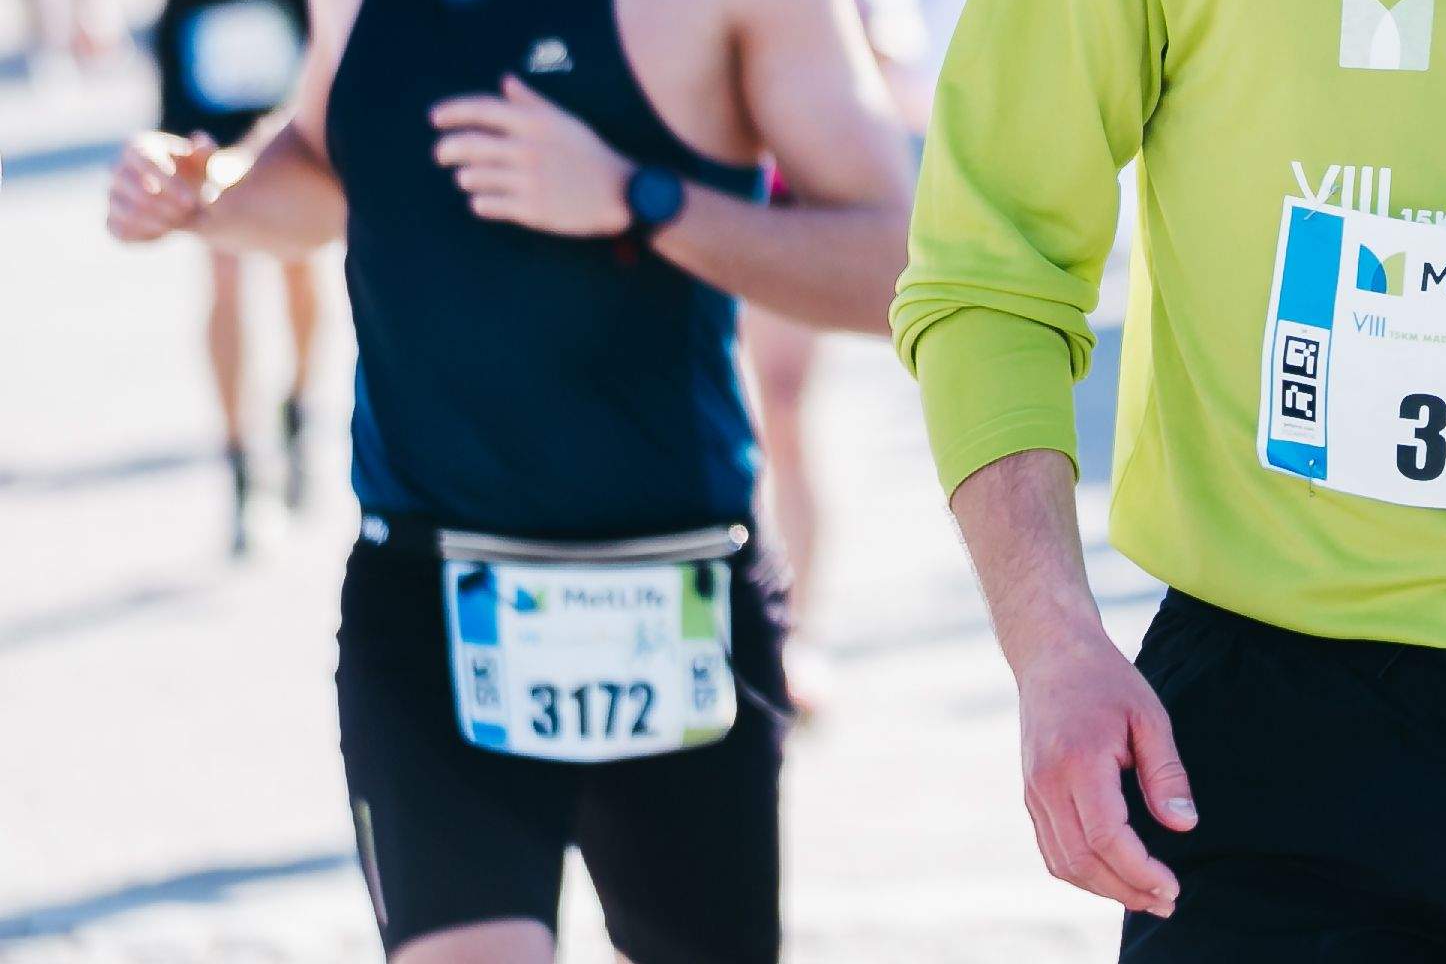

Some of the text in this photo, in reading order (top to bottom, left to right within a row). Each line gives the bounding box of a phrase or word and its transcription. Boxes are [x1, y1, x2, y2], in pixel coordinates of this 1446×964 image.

[1291, 161, 1392, 220] VIII
[1352, 310, 1387, 339] VIII
[530, 681, 658, 738] 3172
